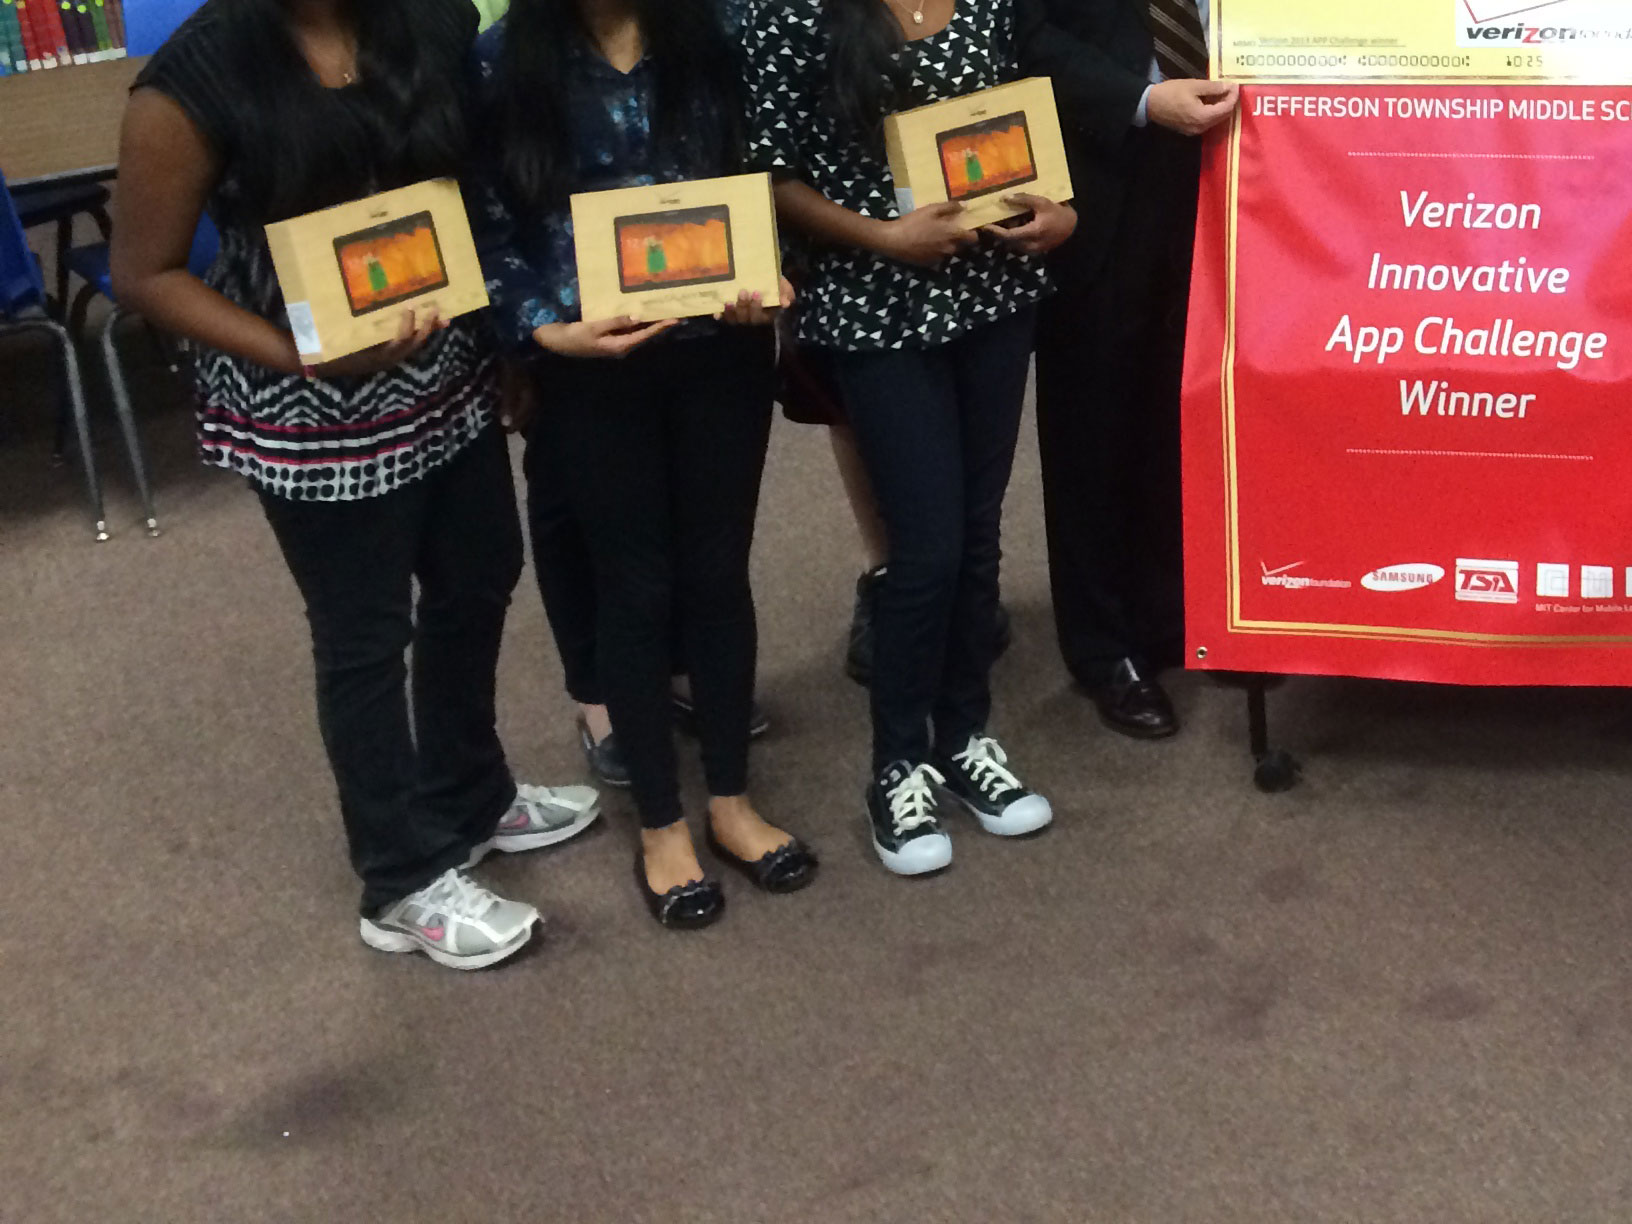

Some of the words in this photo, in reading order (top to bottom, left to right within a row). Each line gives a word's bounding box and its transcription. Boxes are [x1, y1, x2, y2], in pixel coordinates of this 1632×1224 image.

[1253, 96, 1379, 119] JEFFERSON
[1384, 97, 1503, 120] TOWNSHIP
[1508, 99, 1595, 122] MIDDLE
[1400, 190, 1541, 230] Verizon
[1368, 253, 1570, 294] Innovative
[1325, 315, 1403, 362] App
[1415, 317, 1608, 369] Challenge
[1400, 379, 1536, 419] Winner
[1372, 570, 1433, 584] SAMSUNG
